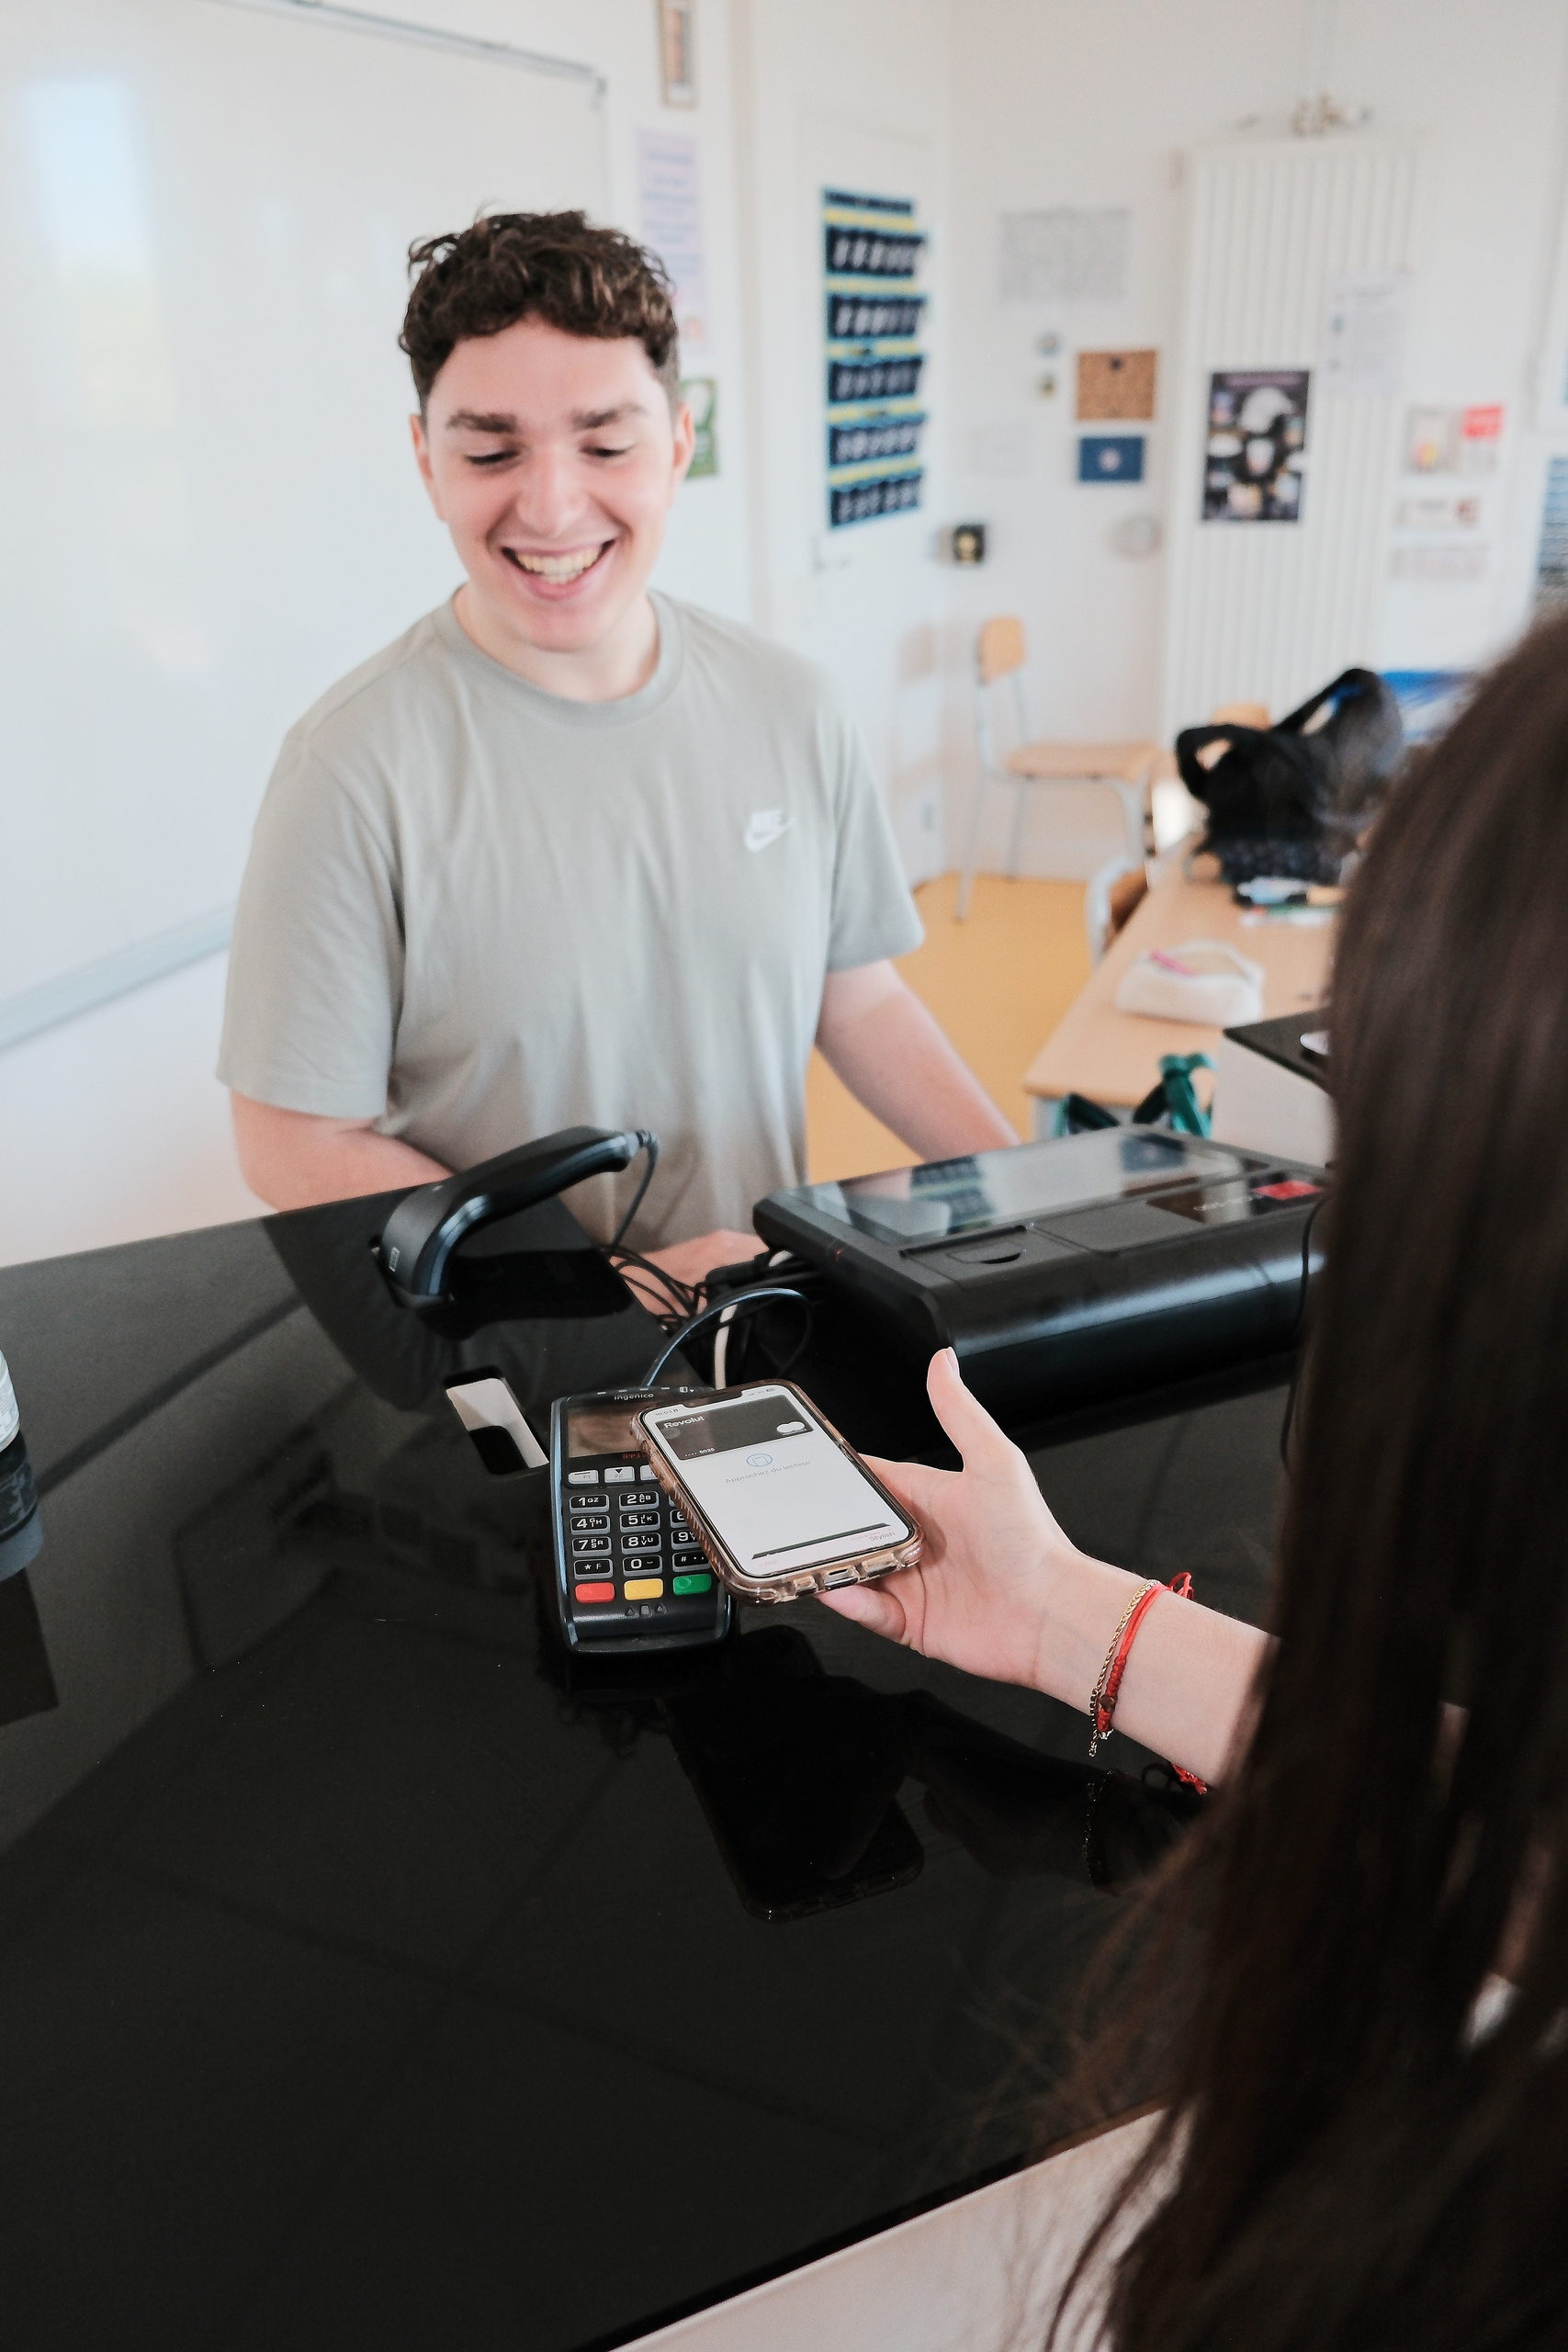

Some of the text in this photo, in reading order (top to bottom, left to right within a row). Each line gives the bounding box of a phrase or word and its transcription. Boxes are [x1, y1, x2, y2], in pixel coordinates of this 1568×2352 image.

[614, 1393, 654, 1401] ingenico
[663, 1416, 705, 1429] Revolut
[726, 1470, 770, 1484] Approchez
